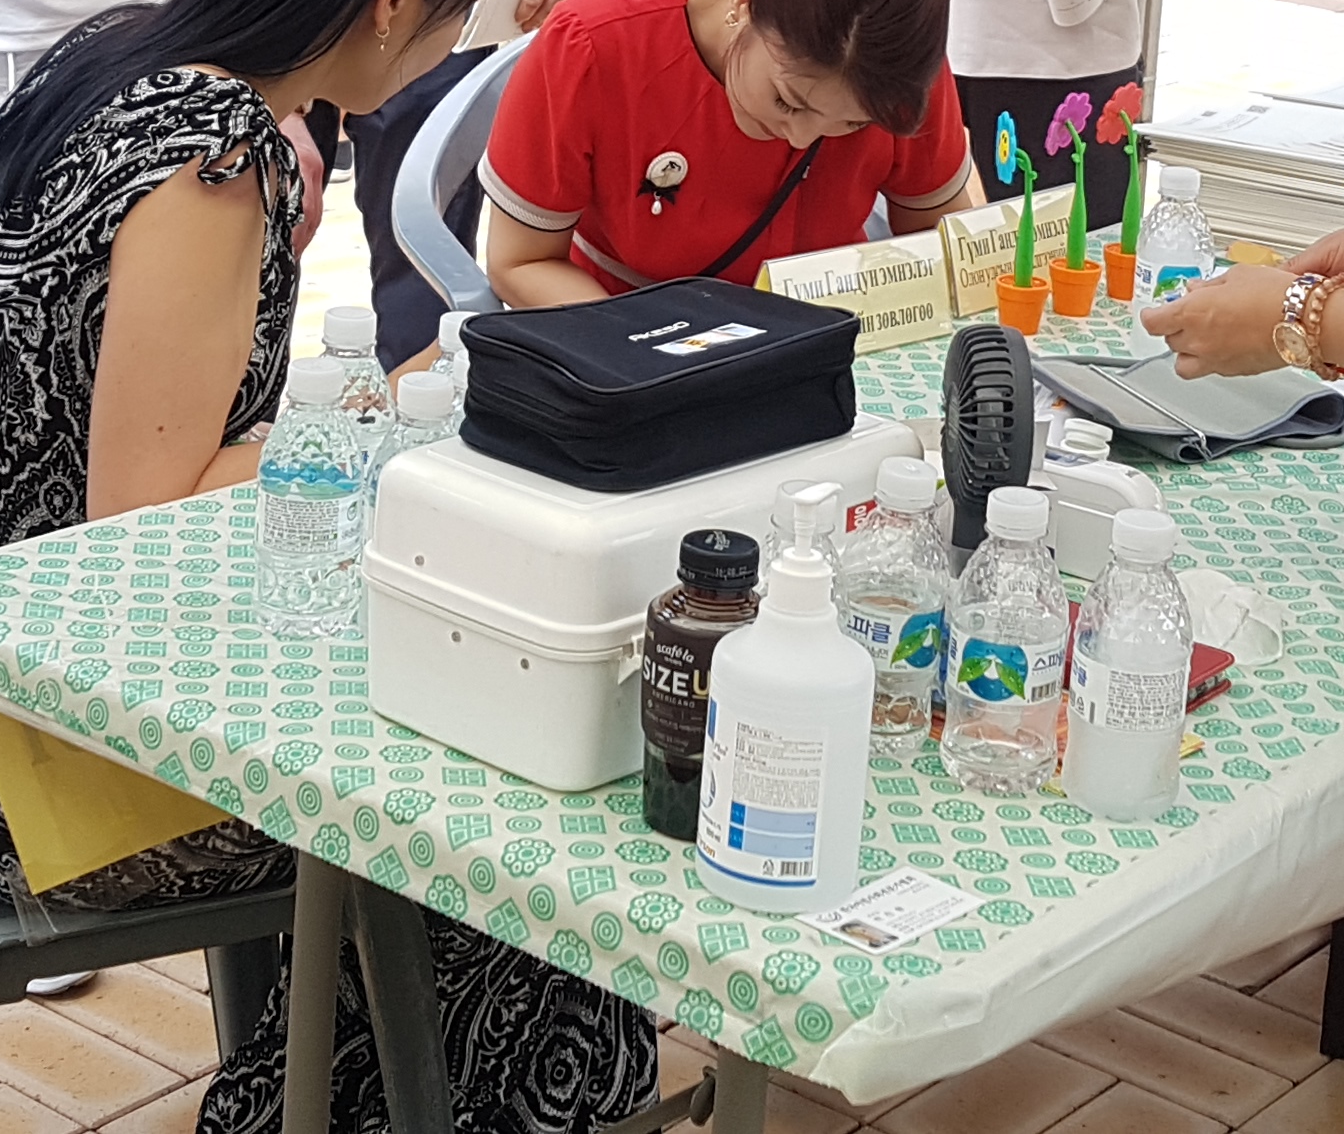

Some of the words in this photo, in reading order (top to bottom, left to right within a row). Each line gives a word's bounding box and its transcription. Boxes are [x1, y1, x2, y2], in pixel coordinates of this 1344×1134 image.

[956, 236, 991, 264] Гуми
[642, 654, 690, 697] SIZE
[692, 669, 711, 696] U
